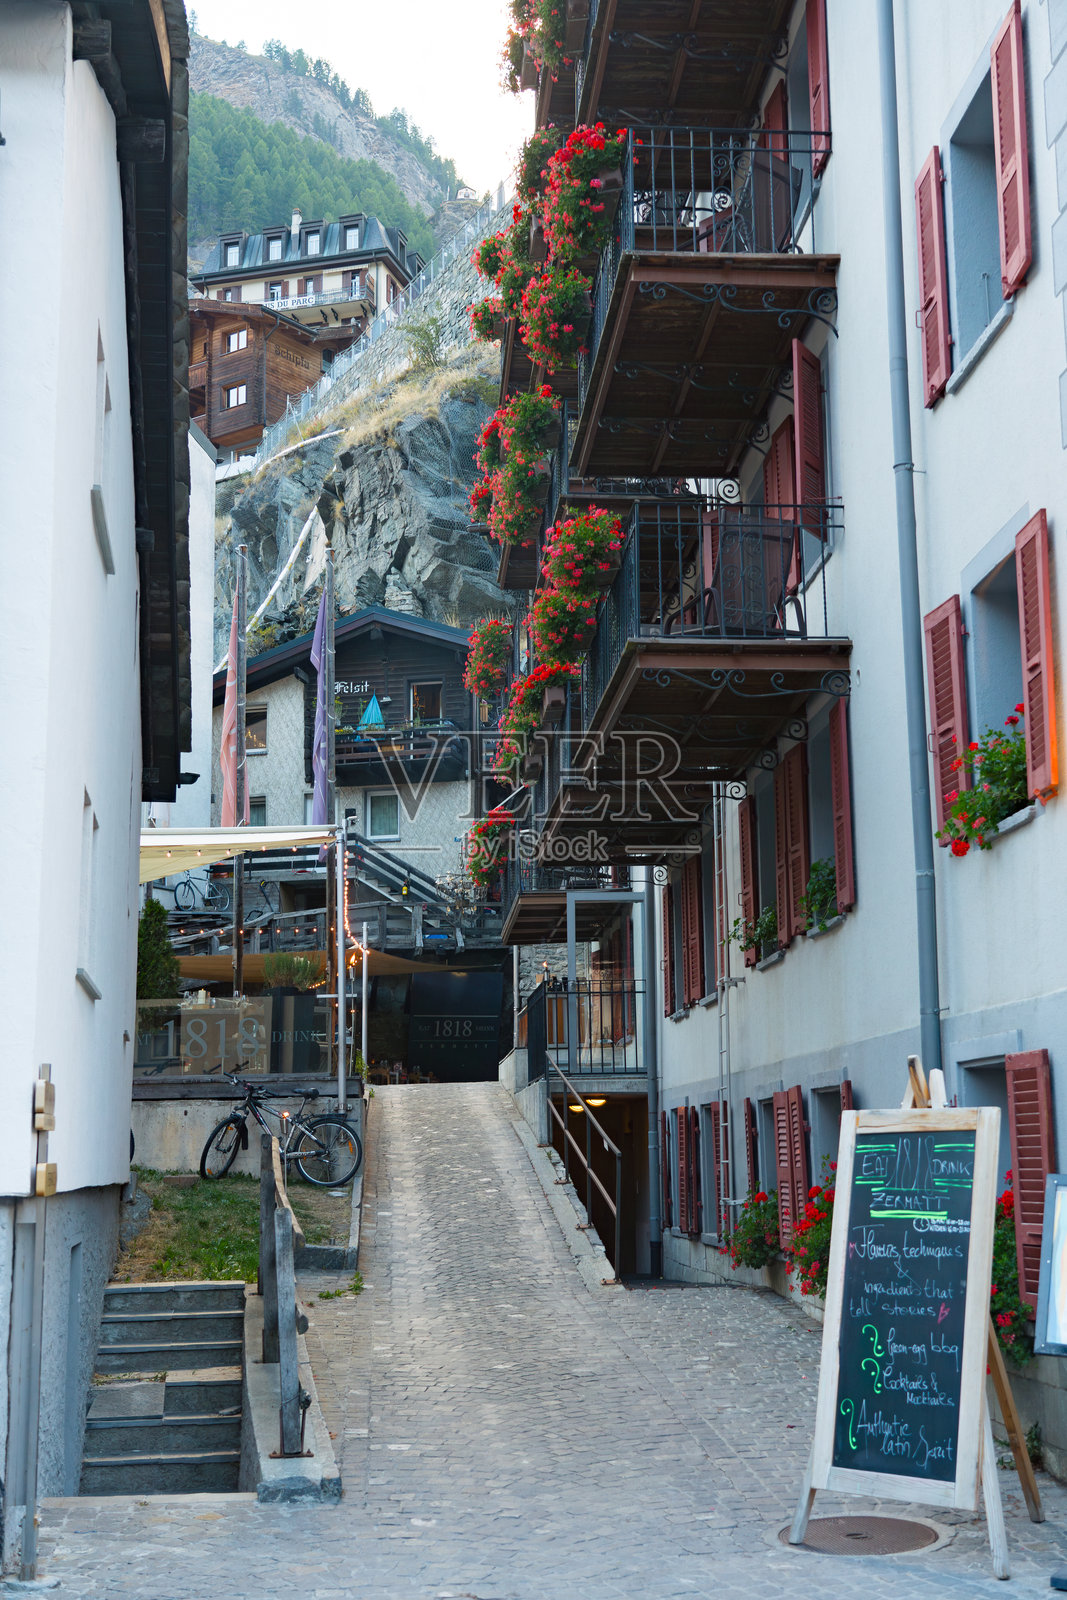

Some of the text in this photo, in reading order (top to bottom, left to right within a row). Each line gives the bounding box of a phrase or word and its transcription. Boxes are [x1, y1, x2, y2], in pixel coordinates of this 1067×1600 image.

[277, 300, 289, 308] DU
[291, 296, 314, 306] PARC
[334, 680, 370, 695] Felsit
[163, 1017, 260, 1059] 1818
[272, 1030, 321, 1043] DRINK
[434, 1020, 473, 1037] 1818
[862, 1135, 974, 1196] EAT 1818 DRINK
[869, 1192, 951, 1210] ZERMATT
[902, 1230, 964, 1271] techniques
[924, 1278, 953, 1299] that
[849, 1296, 936, 1318] tell stories
[930, 1331, 959, 1373] bbq
[883, 1365, 938, 1393] Cocktails &
[906, 1391, 955, 1407] Mocktails
[856, 1398, 912, 1459] Authentic
[912, 1424, 953, 1471] Spirit
